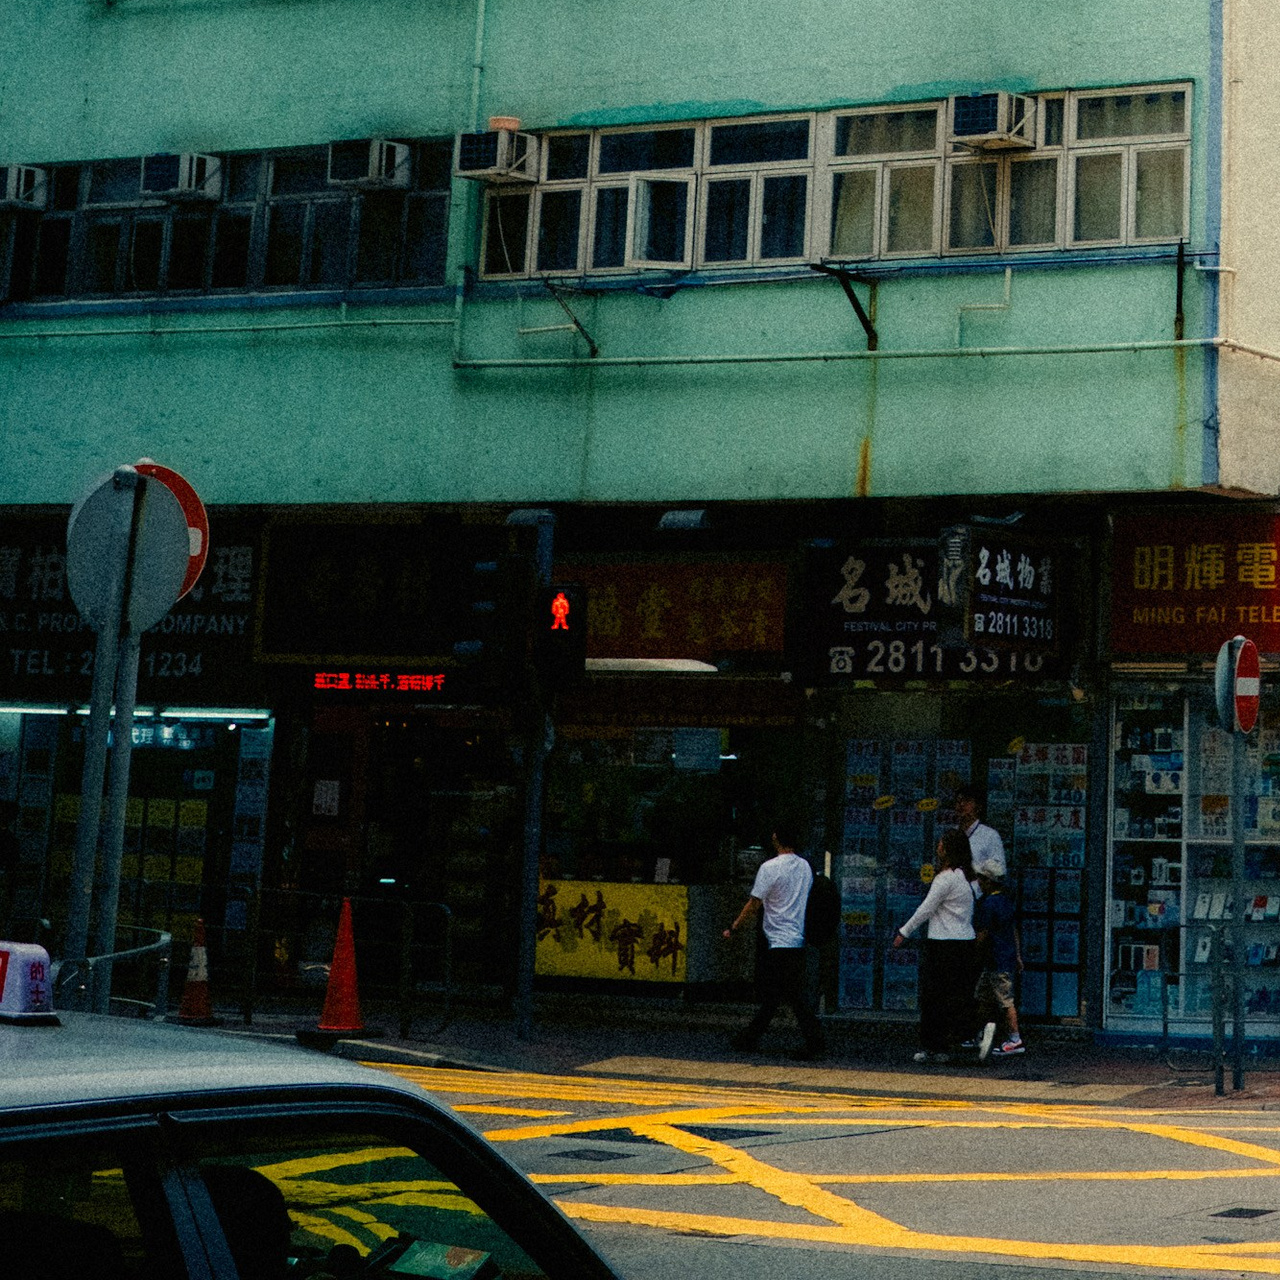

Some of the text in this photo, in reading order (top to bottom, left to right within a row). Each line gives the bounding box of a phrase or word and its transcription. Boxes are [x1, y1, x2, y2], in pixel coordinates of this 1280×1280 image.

[895, 621, 919, 632] CITY
[988, 611, 1019, 636] 2811
[1132, 606, 1185, 624] MING
[1196, 606, 1226, 623] FAI
[866, 639, 943, 673] 2811
[30, 961, 46, 1004] 的士
